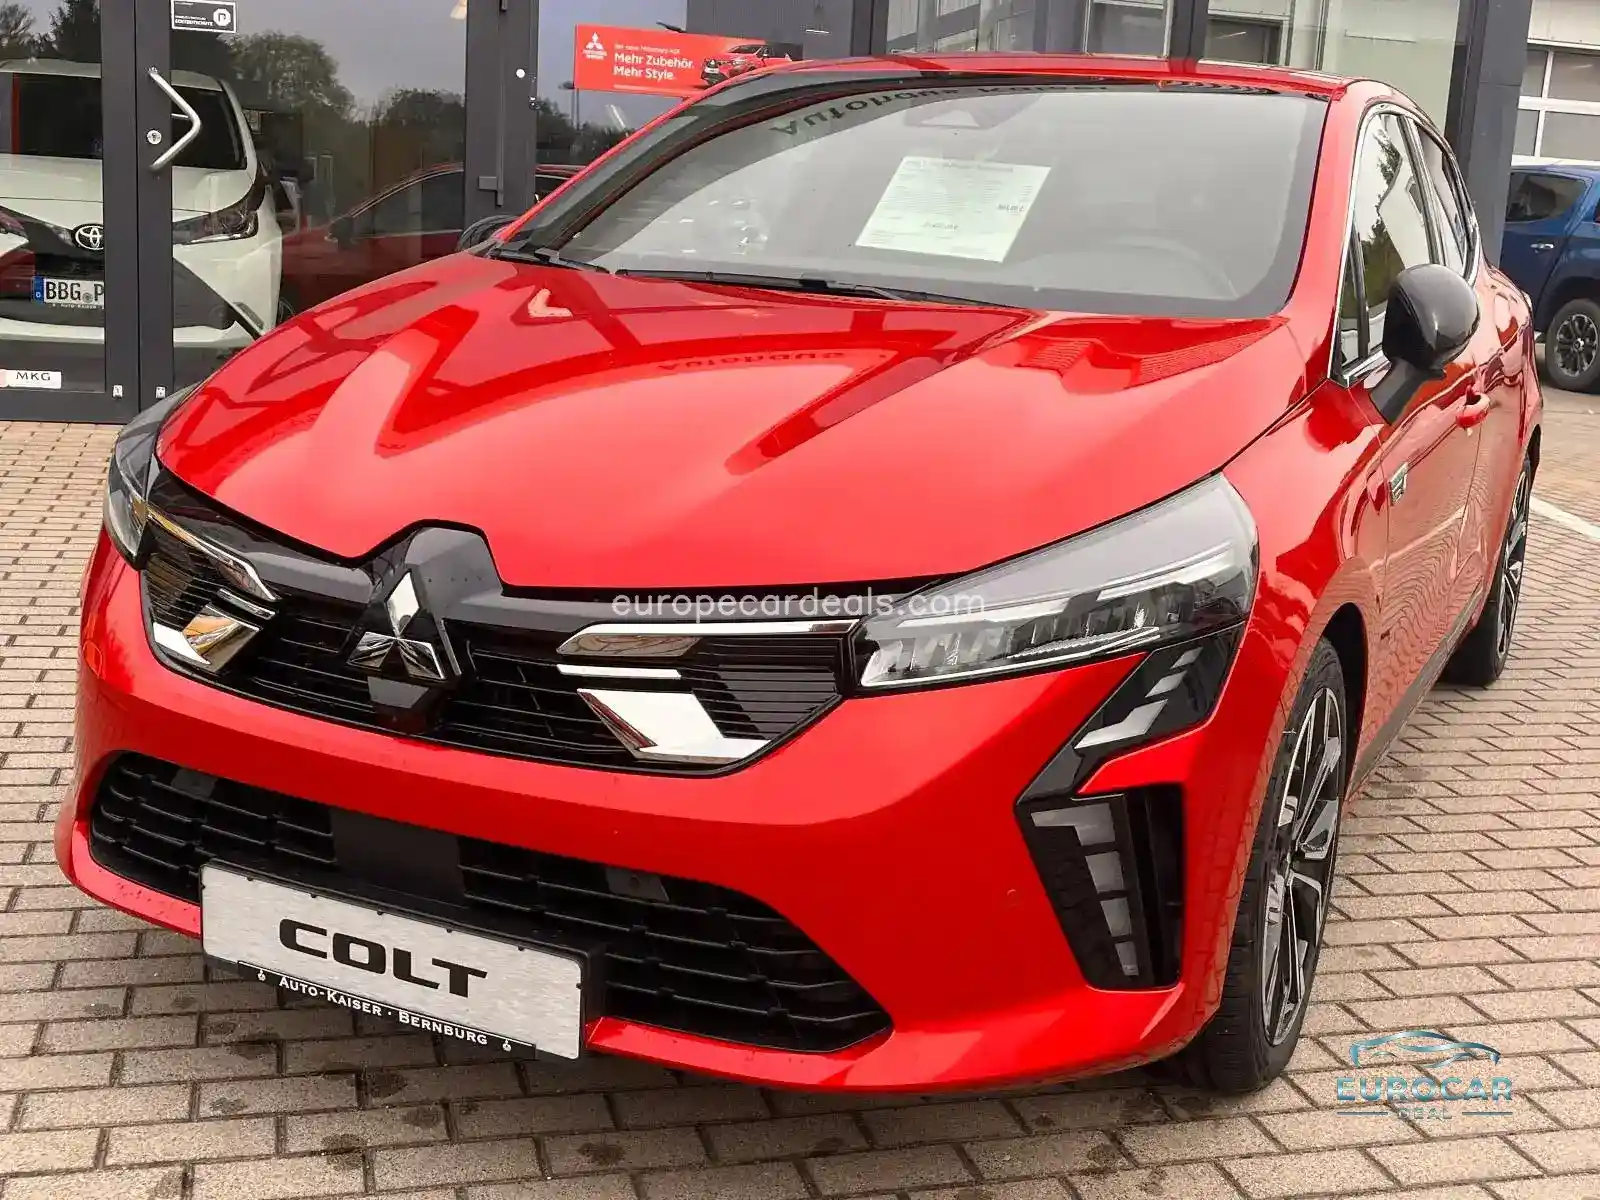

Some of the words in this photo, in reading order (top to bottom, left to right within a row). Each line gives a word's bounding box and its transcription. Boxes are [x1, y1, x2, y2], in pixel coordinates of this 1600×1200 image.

[614, 53, 644, 64] Mehr
[646, 54, 695, 69] Zubehör.
[613, 65, 644, 77] Mehr
[46, 281, 81, 301] BBG
[16, 371, 51, 381] MKG
[279, 919, 488, 998] COLT
[279, 975, 382, 1017] AUTO-KAISER
[398, 1010, 488, 1046] BERNBURG
